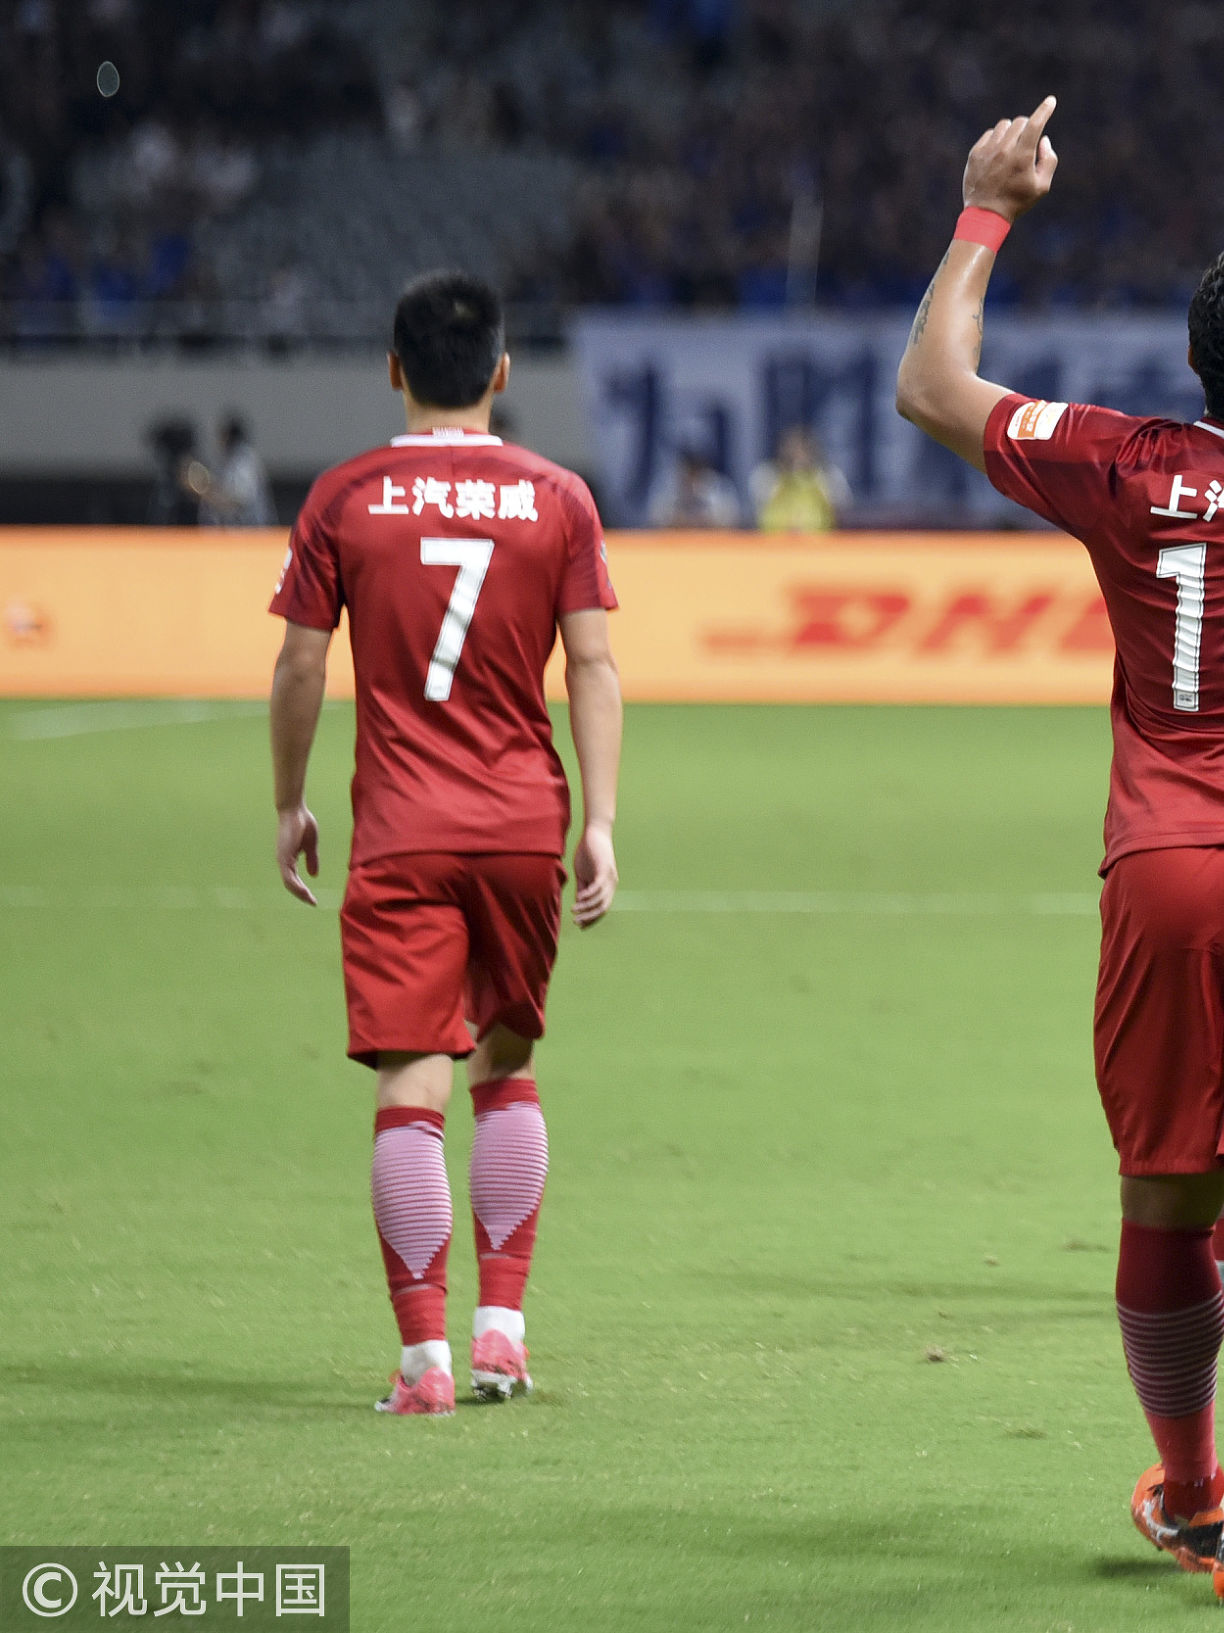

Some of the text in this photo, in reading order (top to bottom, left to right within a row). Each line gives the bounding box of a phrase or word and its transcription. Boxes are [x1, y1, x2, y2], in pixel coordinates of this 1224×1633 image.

[368, 476, 538, 522] 上汽荣威
[420, 536, 495, 702] 7
